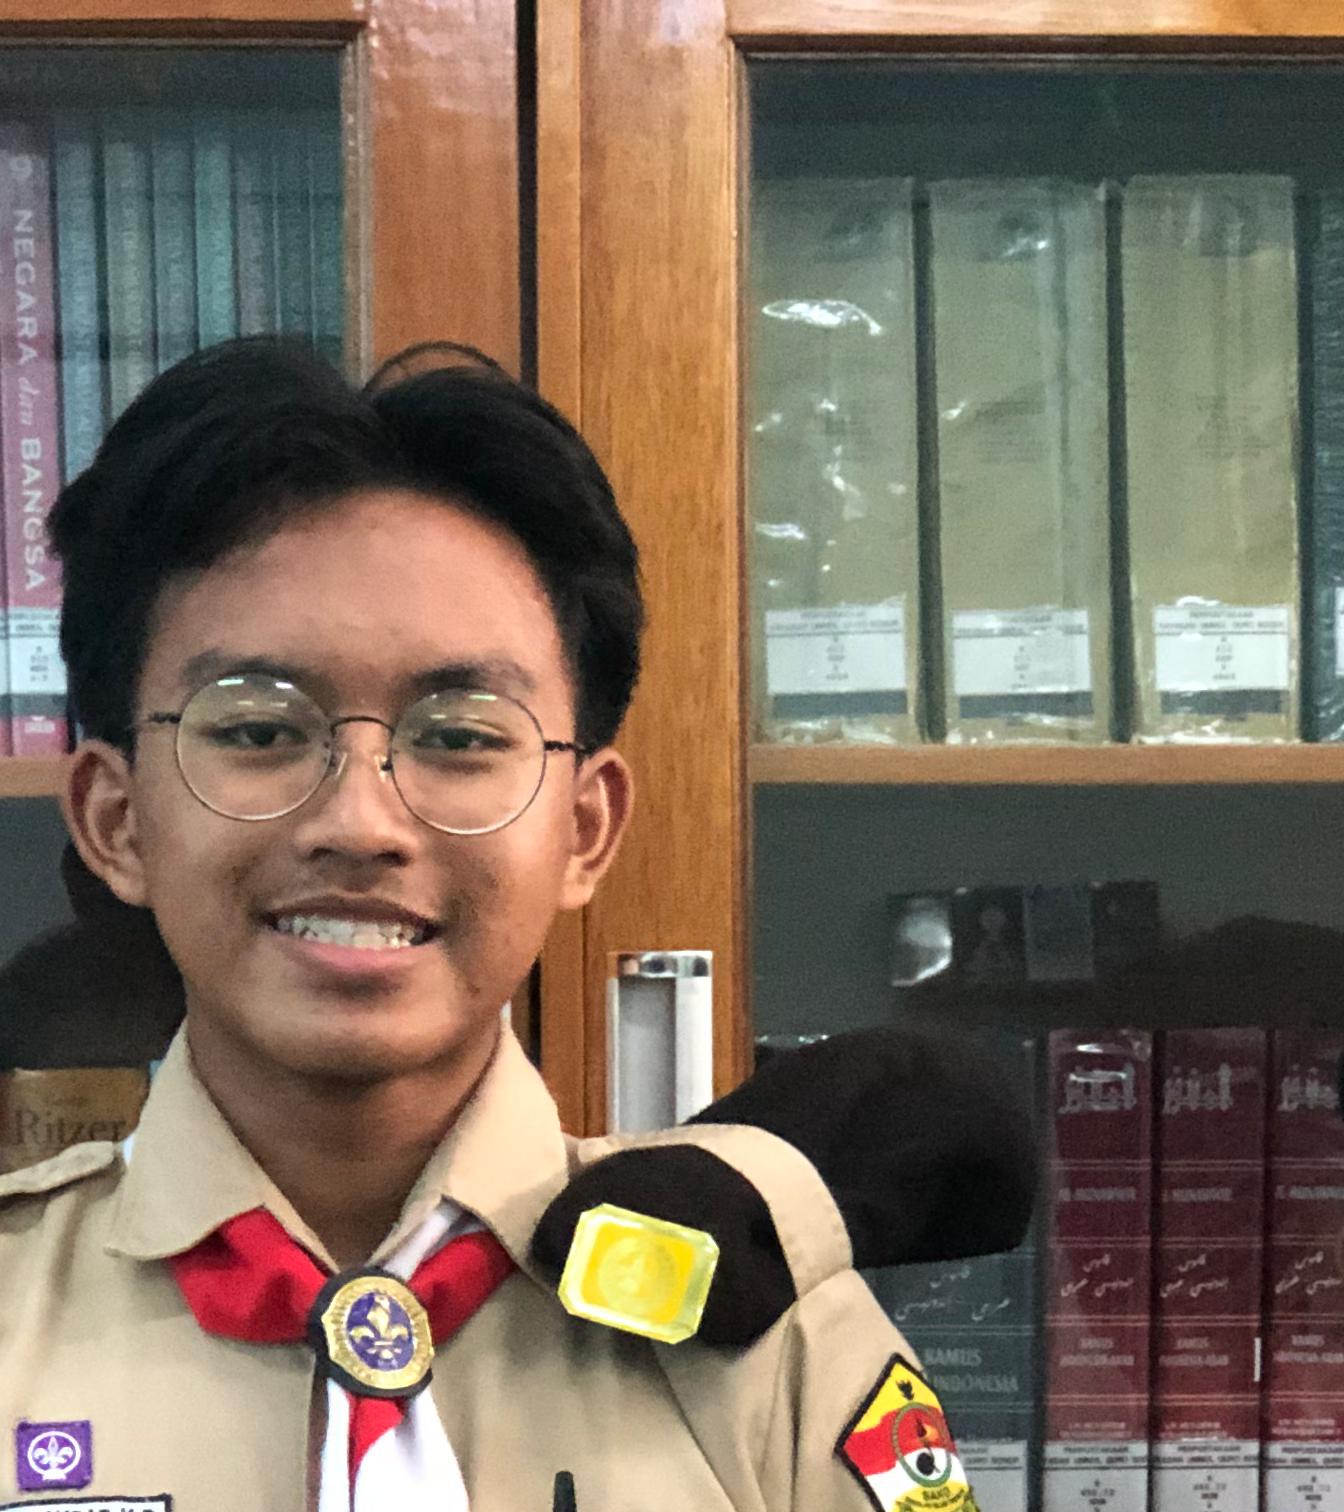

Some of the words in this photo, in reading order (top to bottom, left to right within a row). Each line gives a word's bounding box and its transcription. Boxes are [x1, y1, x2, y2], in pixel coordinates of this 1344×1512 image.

[13, 208, 38, 367] NEGARA
[17, 376, 40, 427] dan
[21, 438, 46, 590] BANGSA
[15, 1109, 131, 1145] Ritzer
